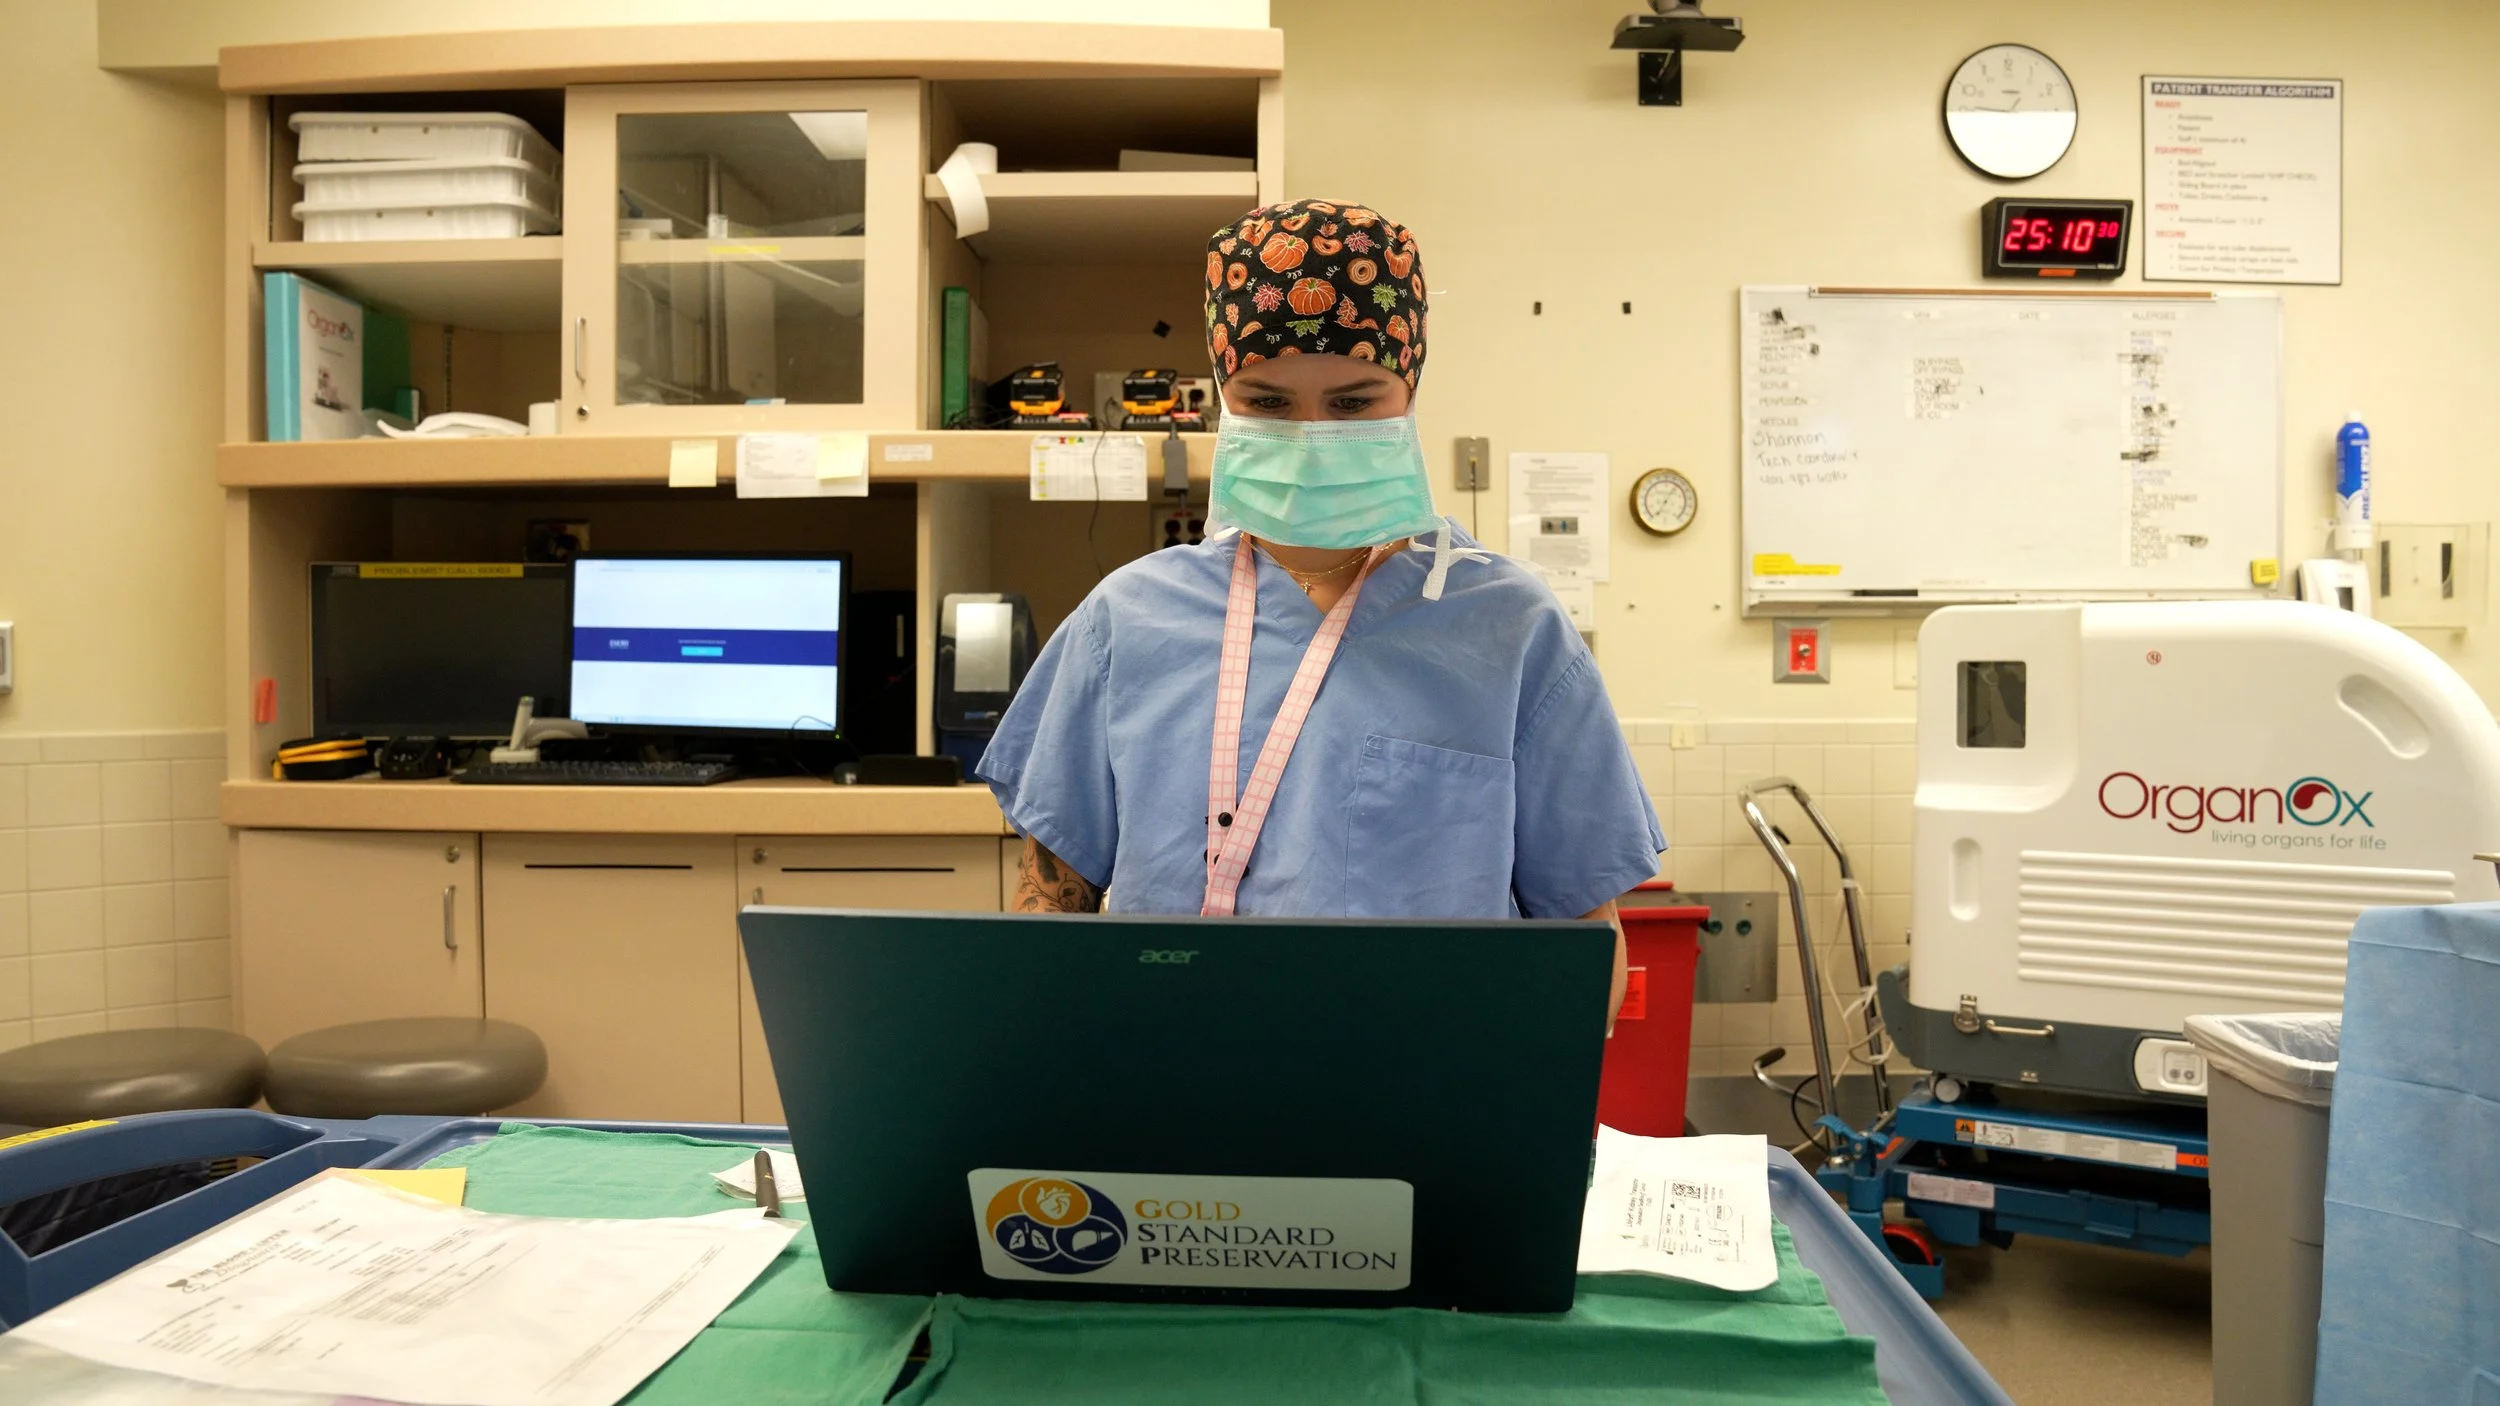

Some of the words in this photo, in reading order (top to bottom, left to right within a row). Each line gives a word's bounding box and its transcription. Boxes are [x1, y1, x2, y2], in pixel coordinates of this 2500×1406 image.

[2154, 83, 2202, 95] PATIENT
[2207, 85, 2263, 97] TRANSFER
[2264, 86, 2331, 98] ALGORITHM
[2155, 146, 2203, 155] EQUIPMENT
[2004, 219, 2095, 253] 25:10
[2098, 222, 2119, 238] 30
[307, 308, 355, 343] OrganOx
[2132, 311, 2176, 321] ALLERGIES
[1760, 416, 1799, 427] NEEDLES
[1752, 430, 1826, 448] Shannon
[2098, 771, 2375, 834] OrganOx
[2211, 829, 2256, 847] living
[2261, 834, 2324, 850] organs
[2330, 834, 2354, 849] for
[2360, 835, 2387, 851] life
[1138, 949, 1200, 964] acer
[1135, 1199, 1242, 1221] GOLD
[1137, 1223, 1335, 1246] STANDARD
[1140, 1246, 1397, 1270] PRESERVATION
